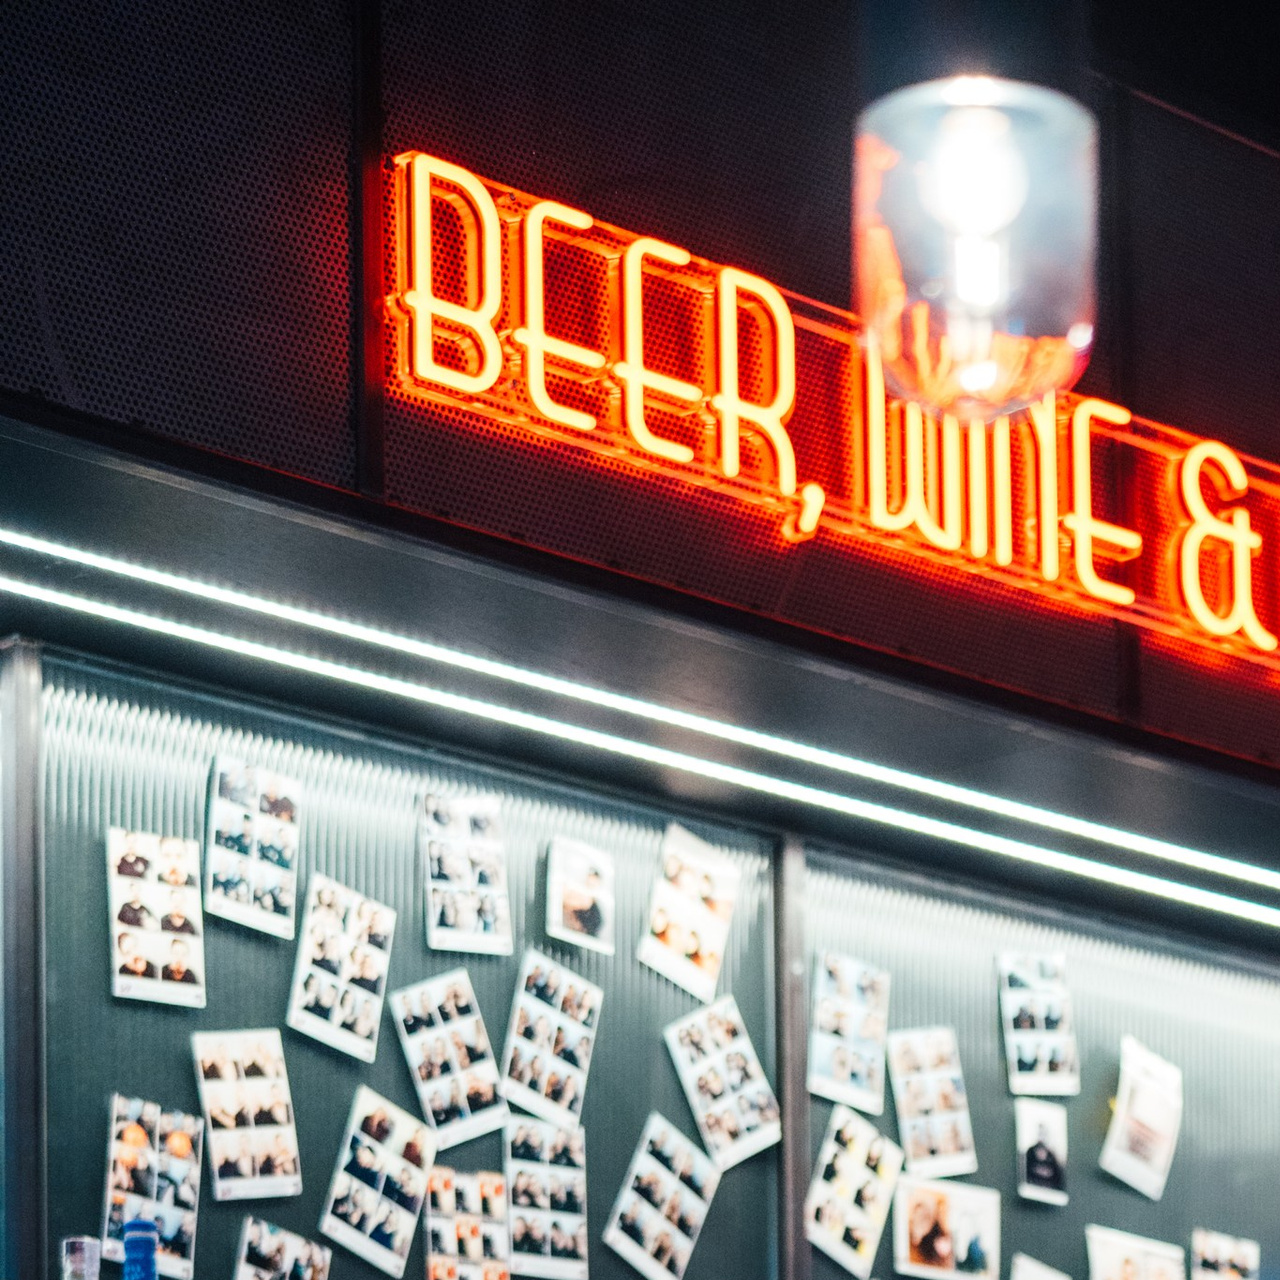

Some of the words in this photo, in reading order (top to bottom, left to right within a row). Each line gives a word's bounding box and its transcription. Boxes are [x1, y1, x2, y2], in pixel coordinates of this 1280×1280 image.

[400, 152, 826, 536] BEER,
[866, 325, 1144, 607] WINE
[1178, 437, 1279, 653] &
